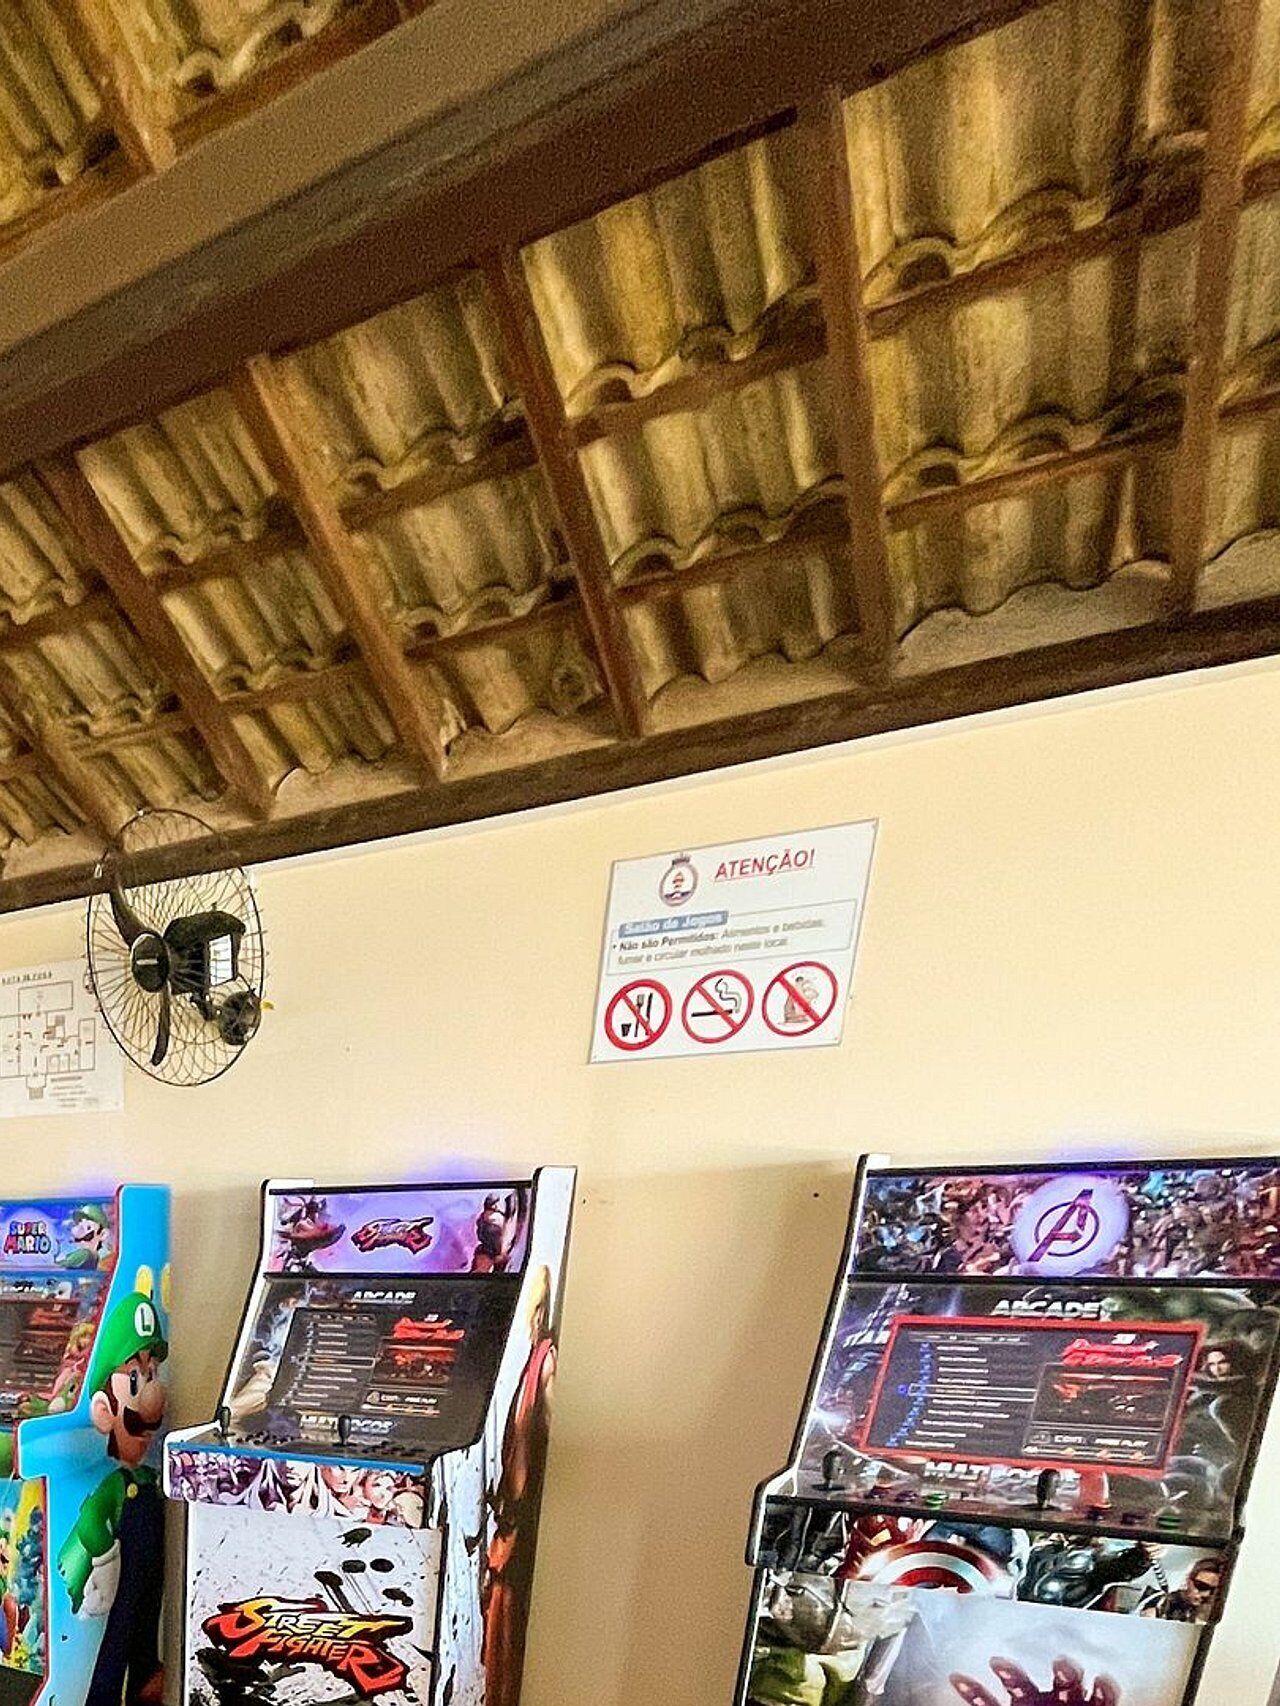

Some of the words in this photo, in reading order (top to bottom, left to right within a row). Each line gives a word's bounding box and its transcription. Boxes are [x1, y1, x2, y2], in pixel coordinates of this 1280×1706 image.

[714, 848, 815, 877] ATENÇÃO!
[9, 1220, 47, 1236] SUPER
[3, 1234, 52, 1255] MARIO
[991, 1299, 1102, 1319] ARCADE
[207, 1597, 407, 1640] STREET
[228, 1628, 406, 1693] FIGHTER
